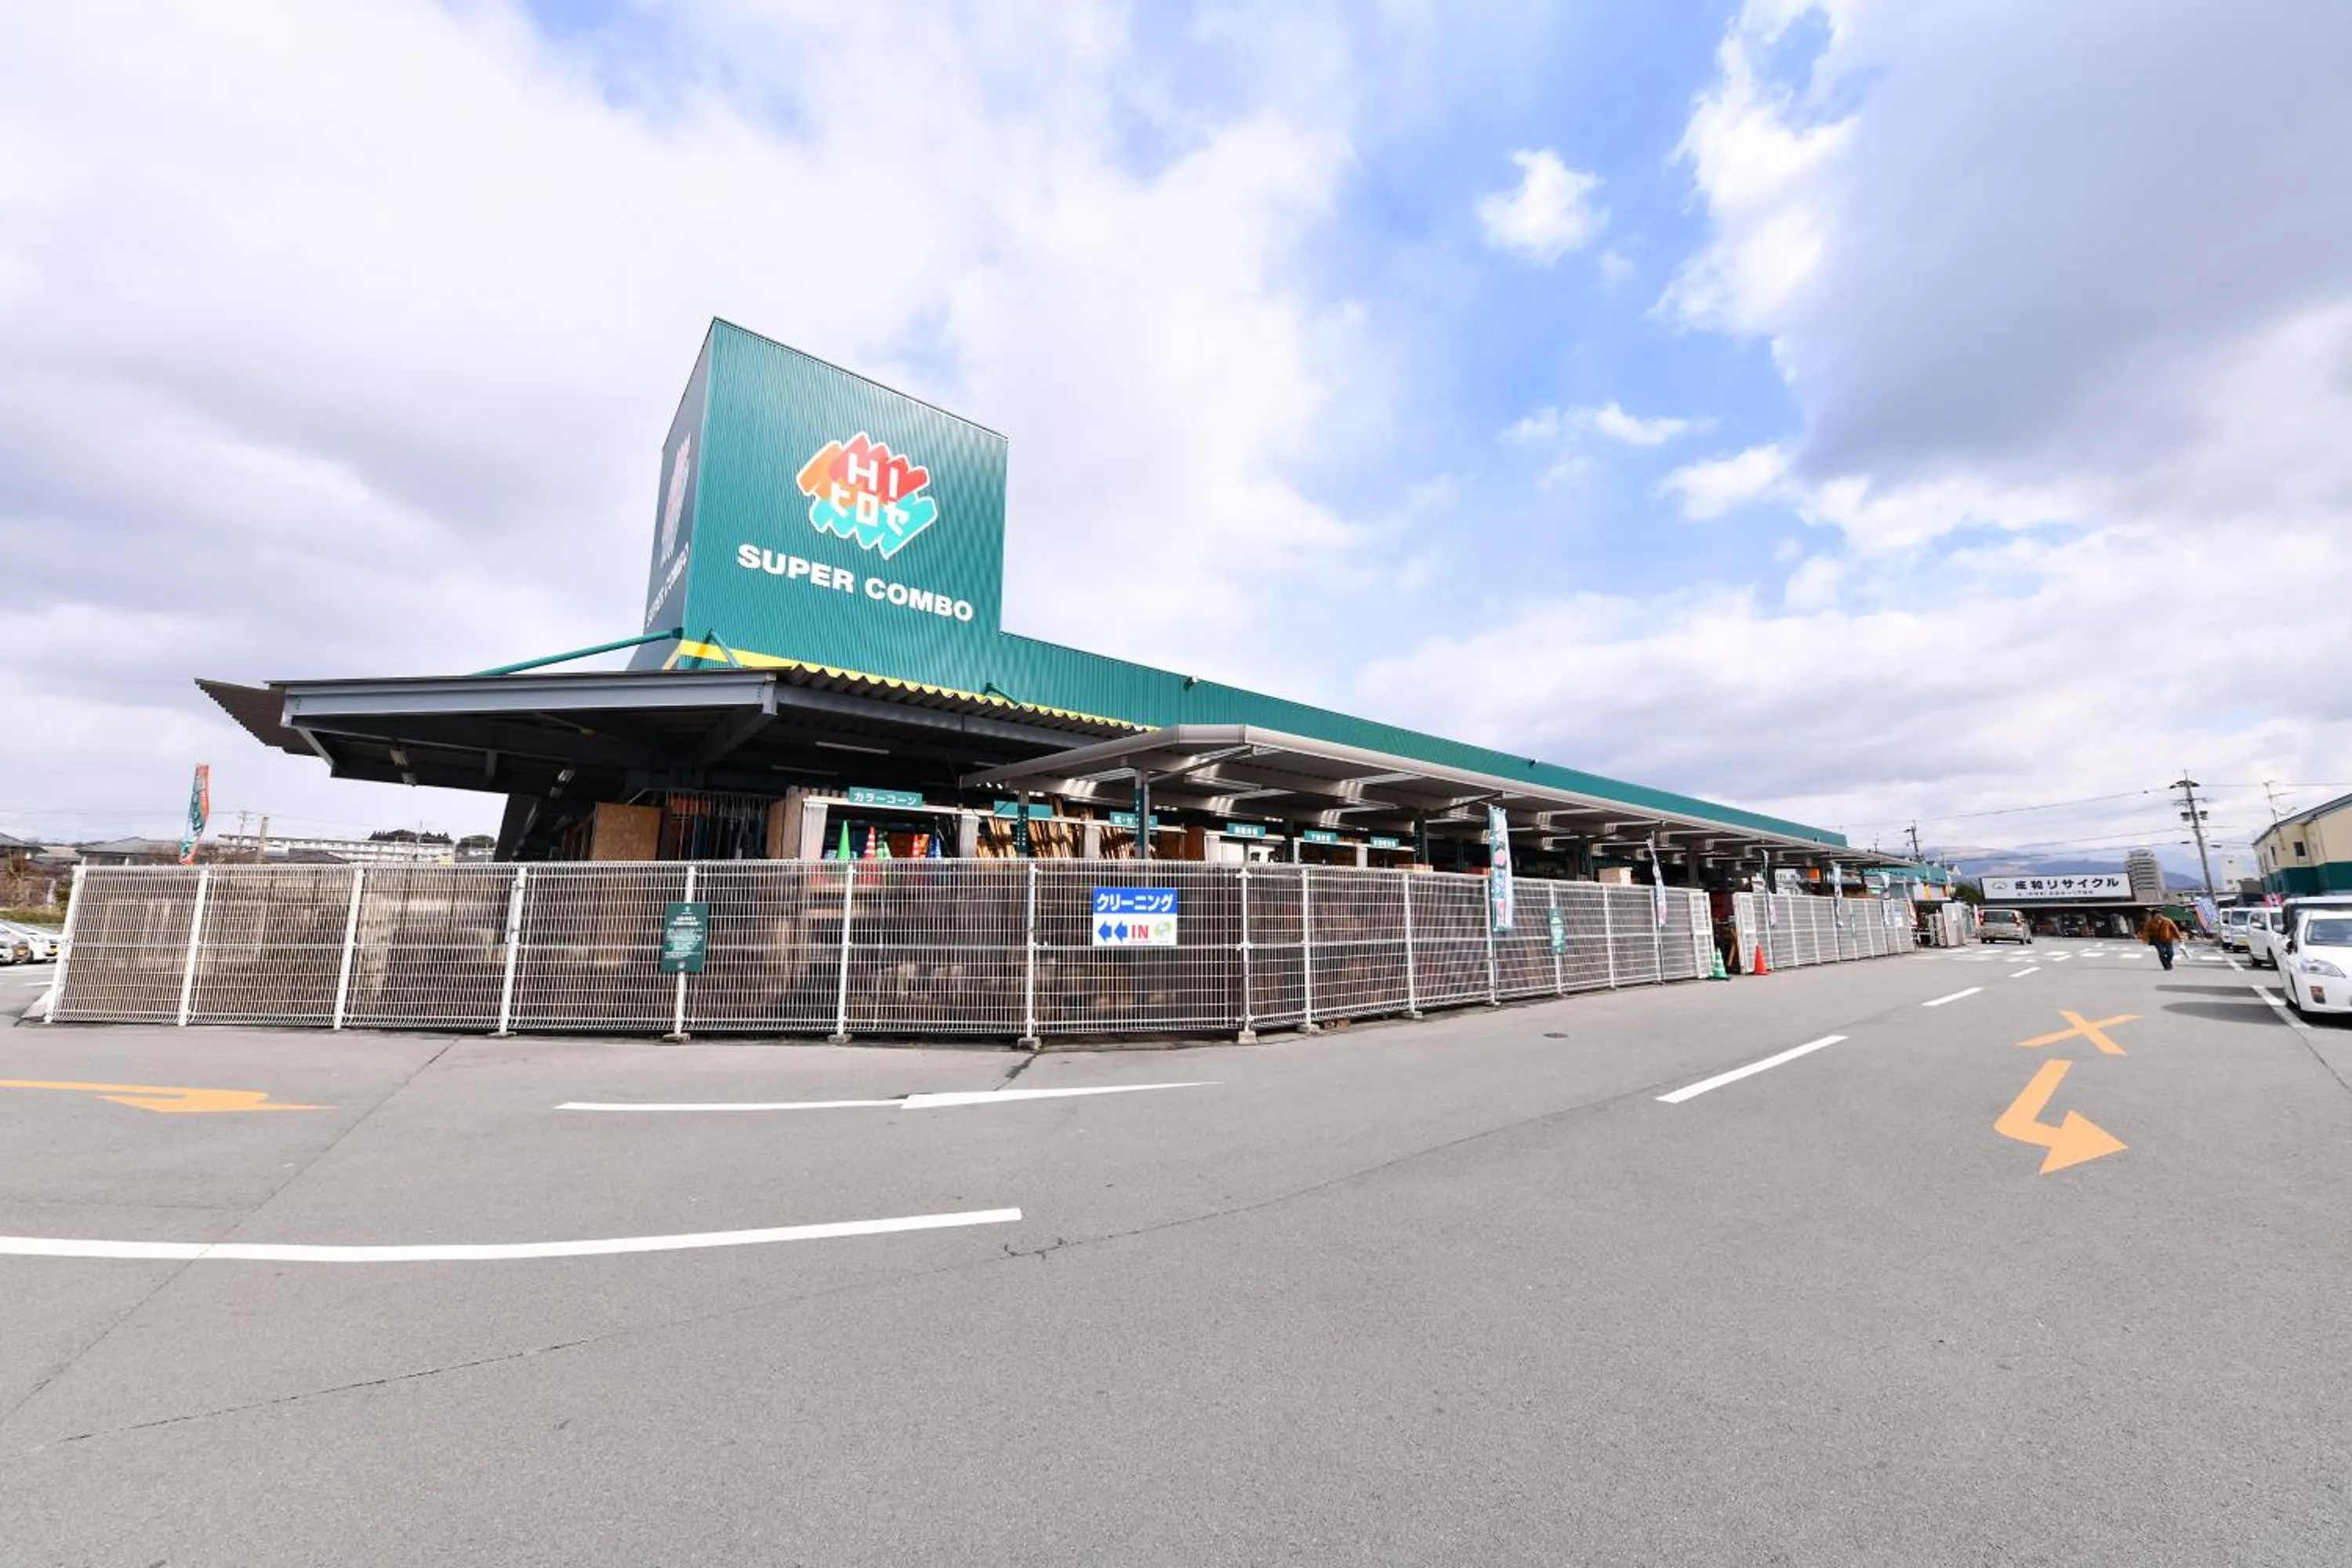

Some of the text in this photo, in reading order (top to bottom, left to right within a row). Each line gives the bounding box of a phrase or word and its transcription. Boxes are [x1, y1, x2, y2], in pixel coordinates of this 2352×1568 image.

[847, 452, 899, 499] HI
[830, 481, 910, 538] ヒロセ
[737, 543, 855, 593] SUPER
[865, 577, 974, 622] COMBO
[854, 791, 916, 805] カラーコーン
[1097, 893, 1174, 912] クリーニング
[1131, 924, 1149, 939] IN
